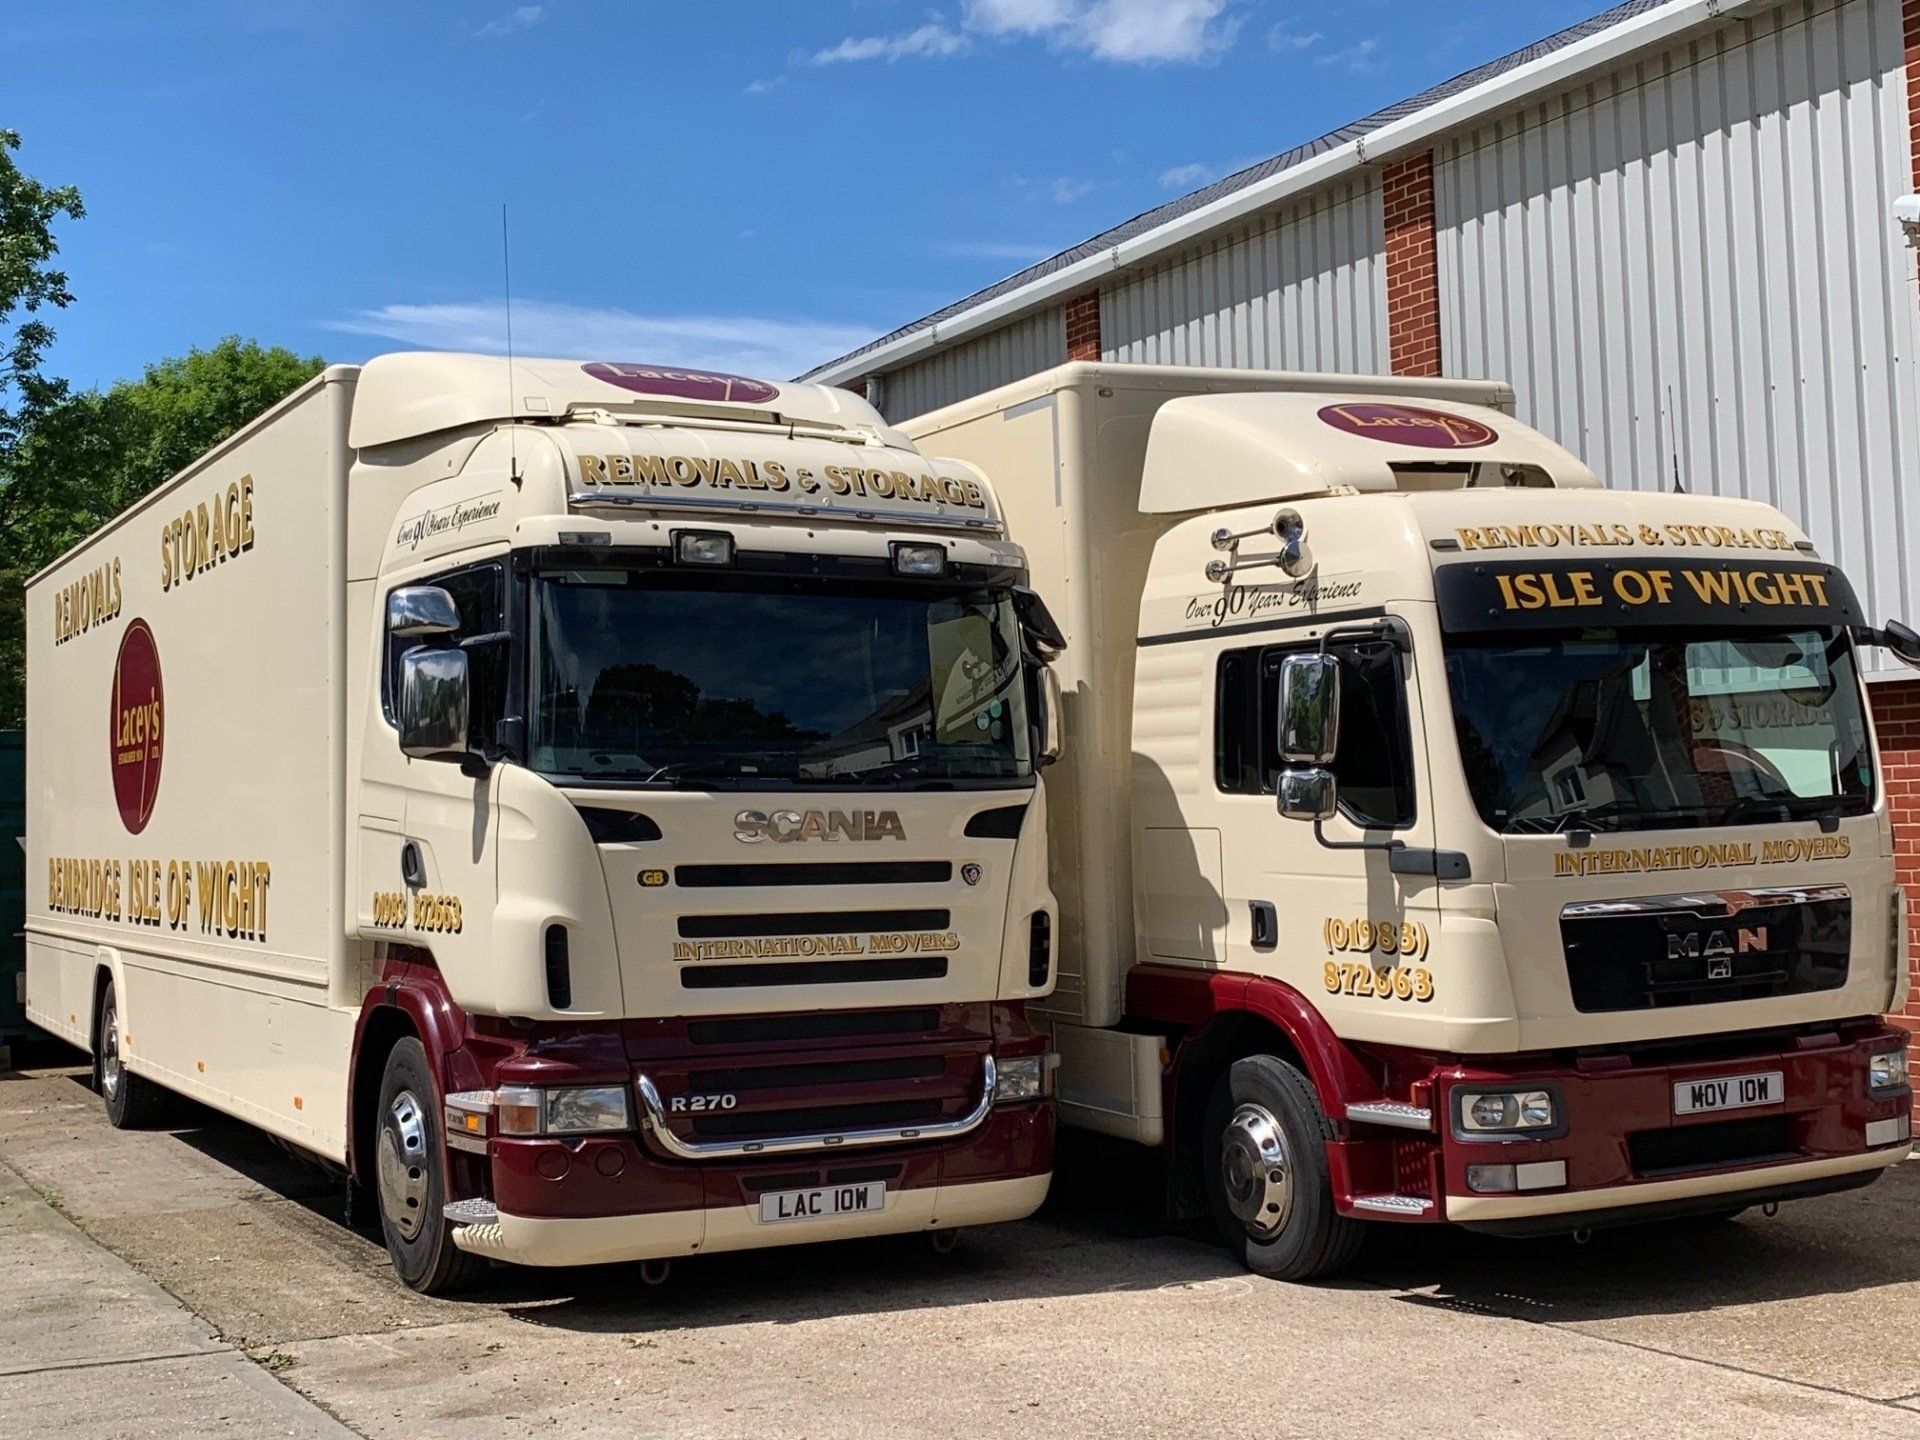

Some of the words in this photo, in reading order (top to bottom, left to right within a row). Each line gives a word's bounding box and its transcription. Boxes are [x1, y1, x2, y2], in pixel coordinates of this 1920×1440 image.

[576, 454, 791, 491] REMOVALS
[796, 467, 820, 494] &
[824, 465, 985, 509] STORAGE
[451, 501, 500, 531] Experience
[1455, 523, 1636, 550] REMOVALS
[1638, 523, 1664, 546] &
[1664, 525, 1796, 551] STORAGE
[55, 556, 122, 646] REMOVALS
[162, 473, 254, 592] STORAGE
[1185, 597, 1211, 620] Over
[1212, 585, 1245, 627] 90
[1248, 587, 1284, 618] Years
[1289, 580, 1362, 608] Experience
[1495, 571, 1603, 610] ISLE
[1612, 569, 1673, 605] OF
[1681, 570, 1830, 608] WIGHT
[733, 809, 907, 844] SCANIA
[1553, 842, 1756, 877] INTERNATIONAL
[1761, 836, 1851, 864] MOVERS
[642, 871, 665, 885] GB
[49, 857, 122, 922] BEMBRIDGE
[127, 858, 161, 926] ISLE
[167, 858, 192, 930] OF
[196, 859, 270, 942] WIGHT
[373, 891, 407, 929] 01983
[413, 894, 462, 934] 872663
[671, 936, 866, 961] INTERNATIONAL
[869, 931, 961, 955] MOVERS
[1324, 917, 1430, 962] (01983)
[1667, 926, 1769, 959] MAN
[1324, 961, 1435, 1003] 872663
[671, 1096, 688, 1112] R
[690, 1093, 737, 1111] 270
[1690, 1082, 1728, 1109] MOV
[778, 1192, 822, 1219] LAC
